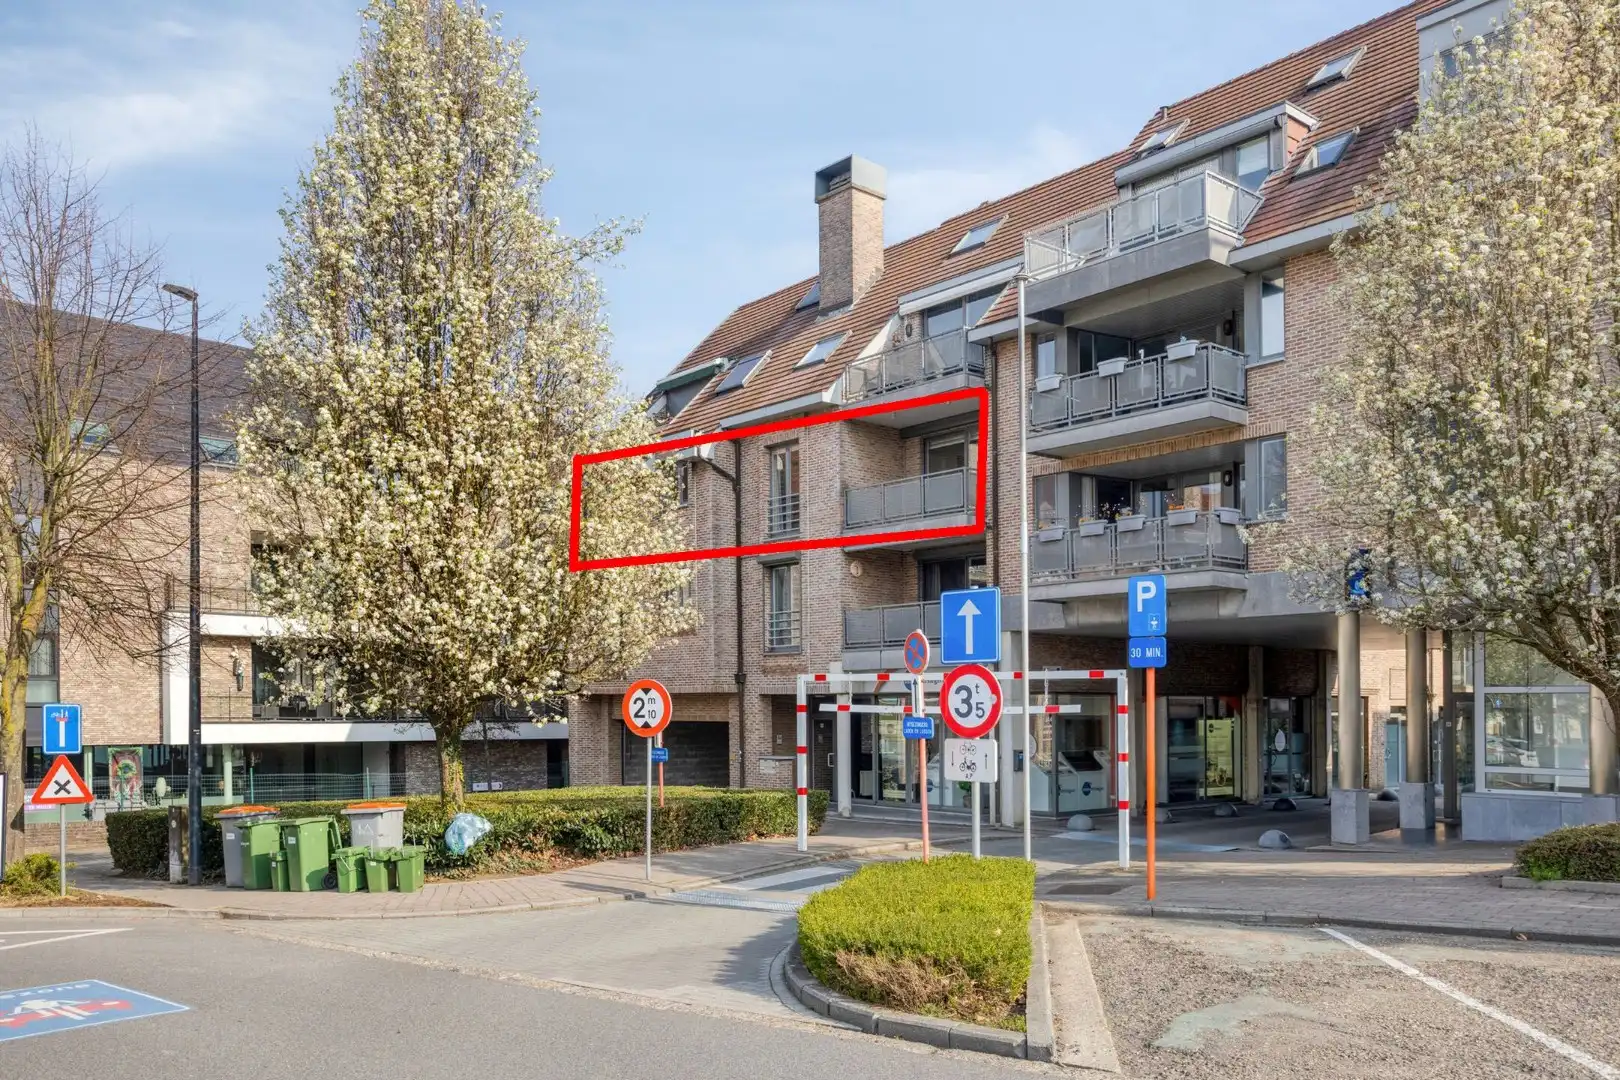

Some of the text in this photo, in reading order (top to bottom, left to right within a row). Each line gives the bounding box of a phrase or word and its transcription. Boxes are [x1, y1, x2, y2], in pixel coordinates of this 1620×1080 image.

[1136, 580, 1157, 613] P
[1130, 647, 1164, 658] 30 MIN.
[975, 683, 980, 694] t
[633, 697, 645, 718] 2
[954, 684, 973, 719] 3
[648, 710, 656, 719] 10
[975, 702, 985, 719] 5
